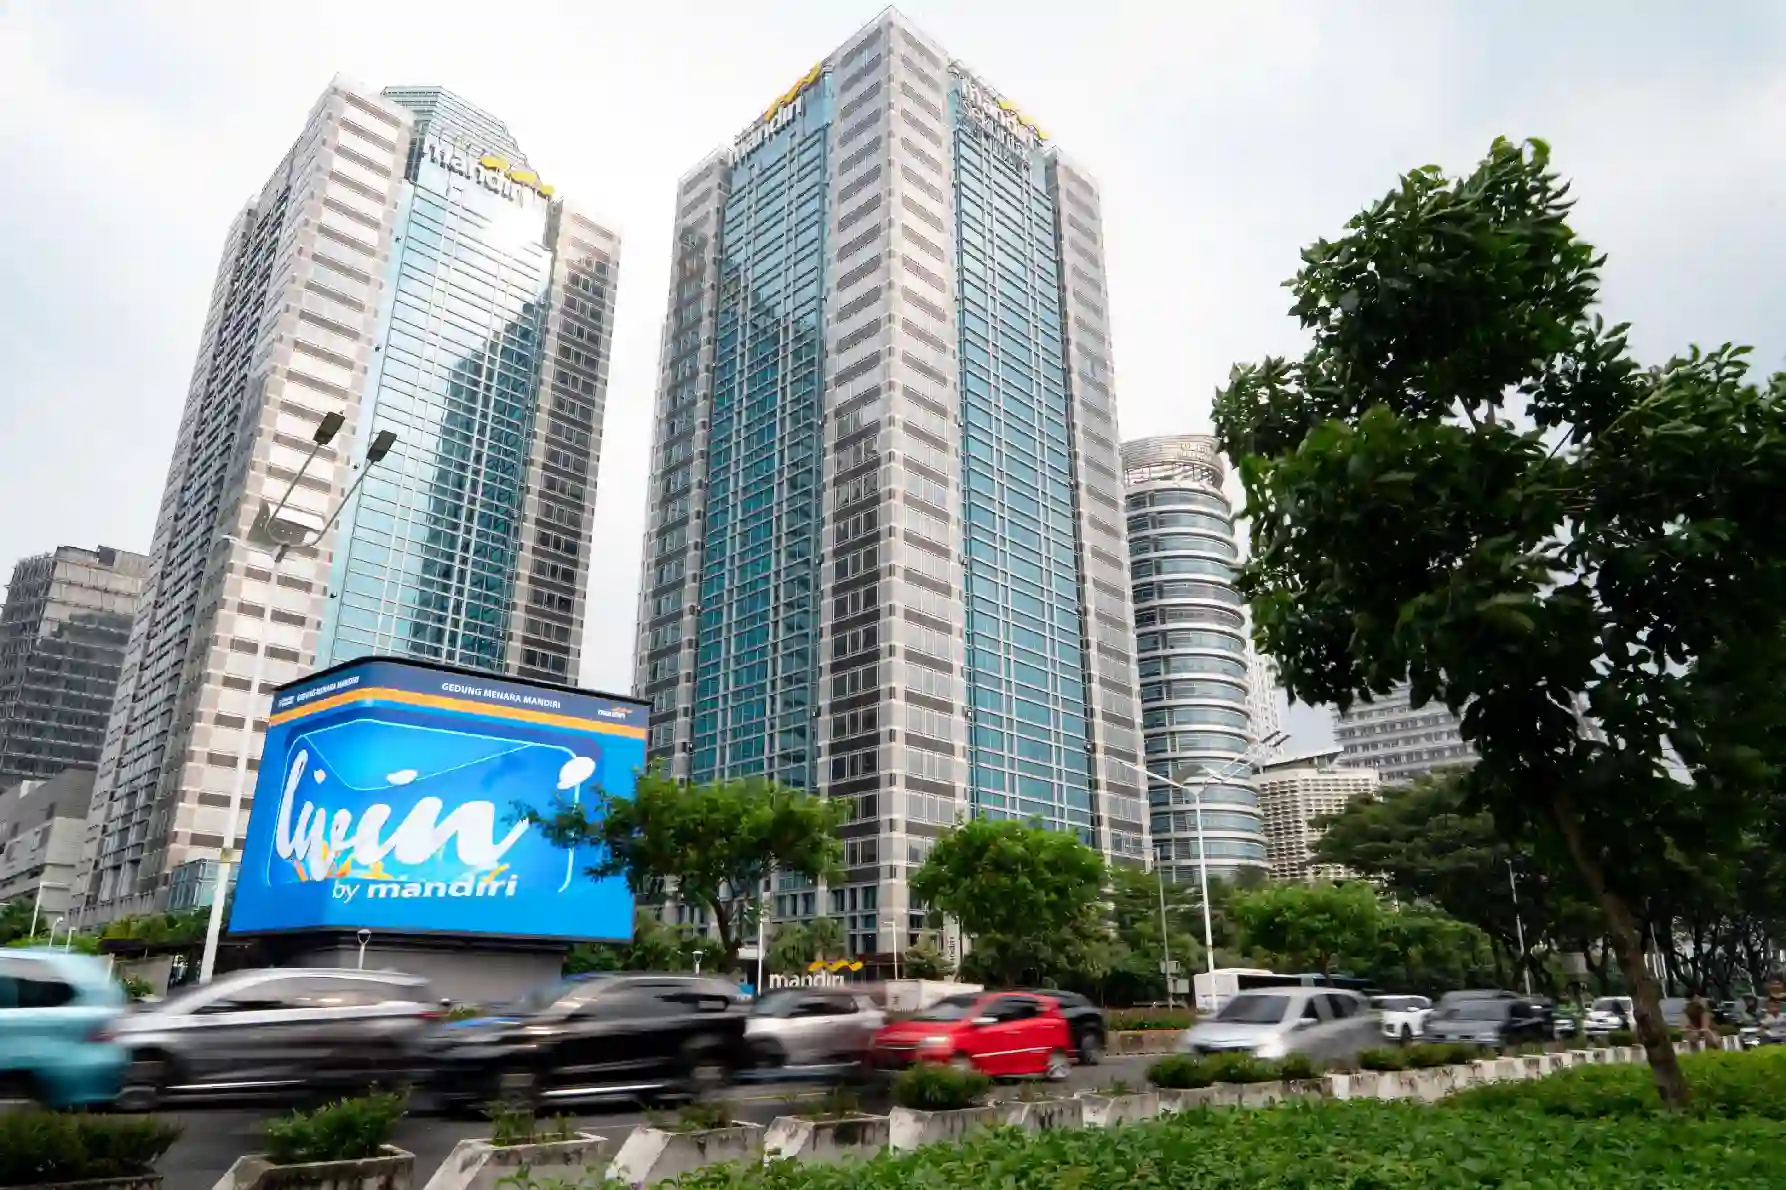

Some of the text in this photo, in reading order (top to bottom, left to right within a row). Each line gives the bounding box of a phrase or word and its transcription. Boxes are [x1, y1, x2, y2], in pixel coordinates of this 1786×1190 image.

[441, 682, 561, 709] GEDUNG MENARA MANDIRI
[331, 873, 519, 904] by mandiri
[769, 968, 845, 989] mandiri
